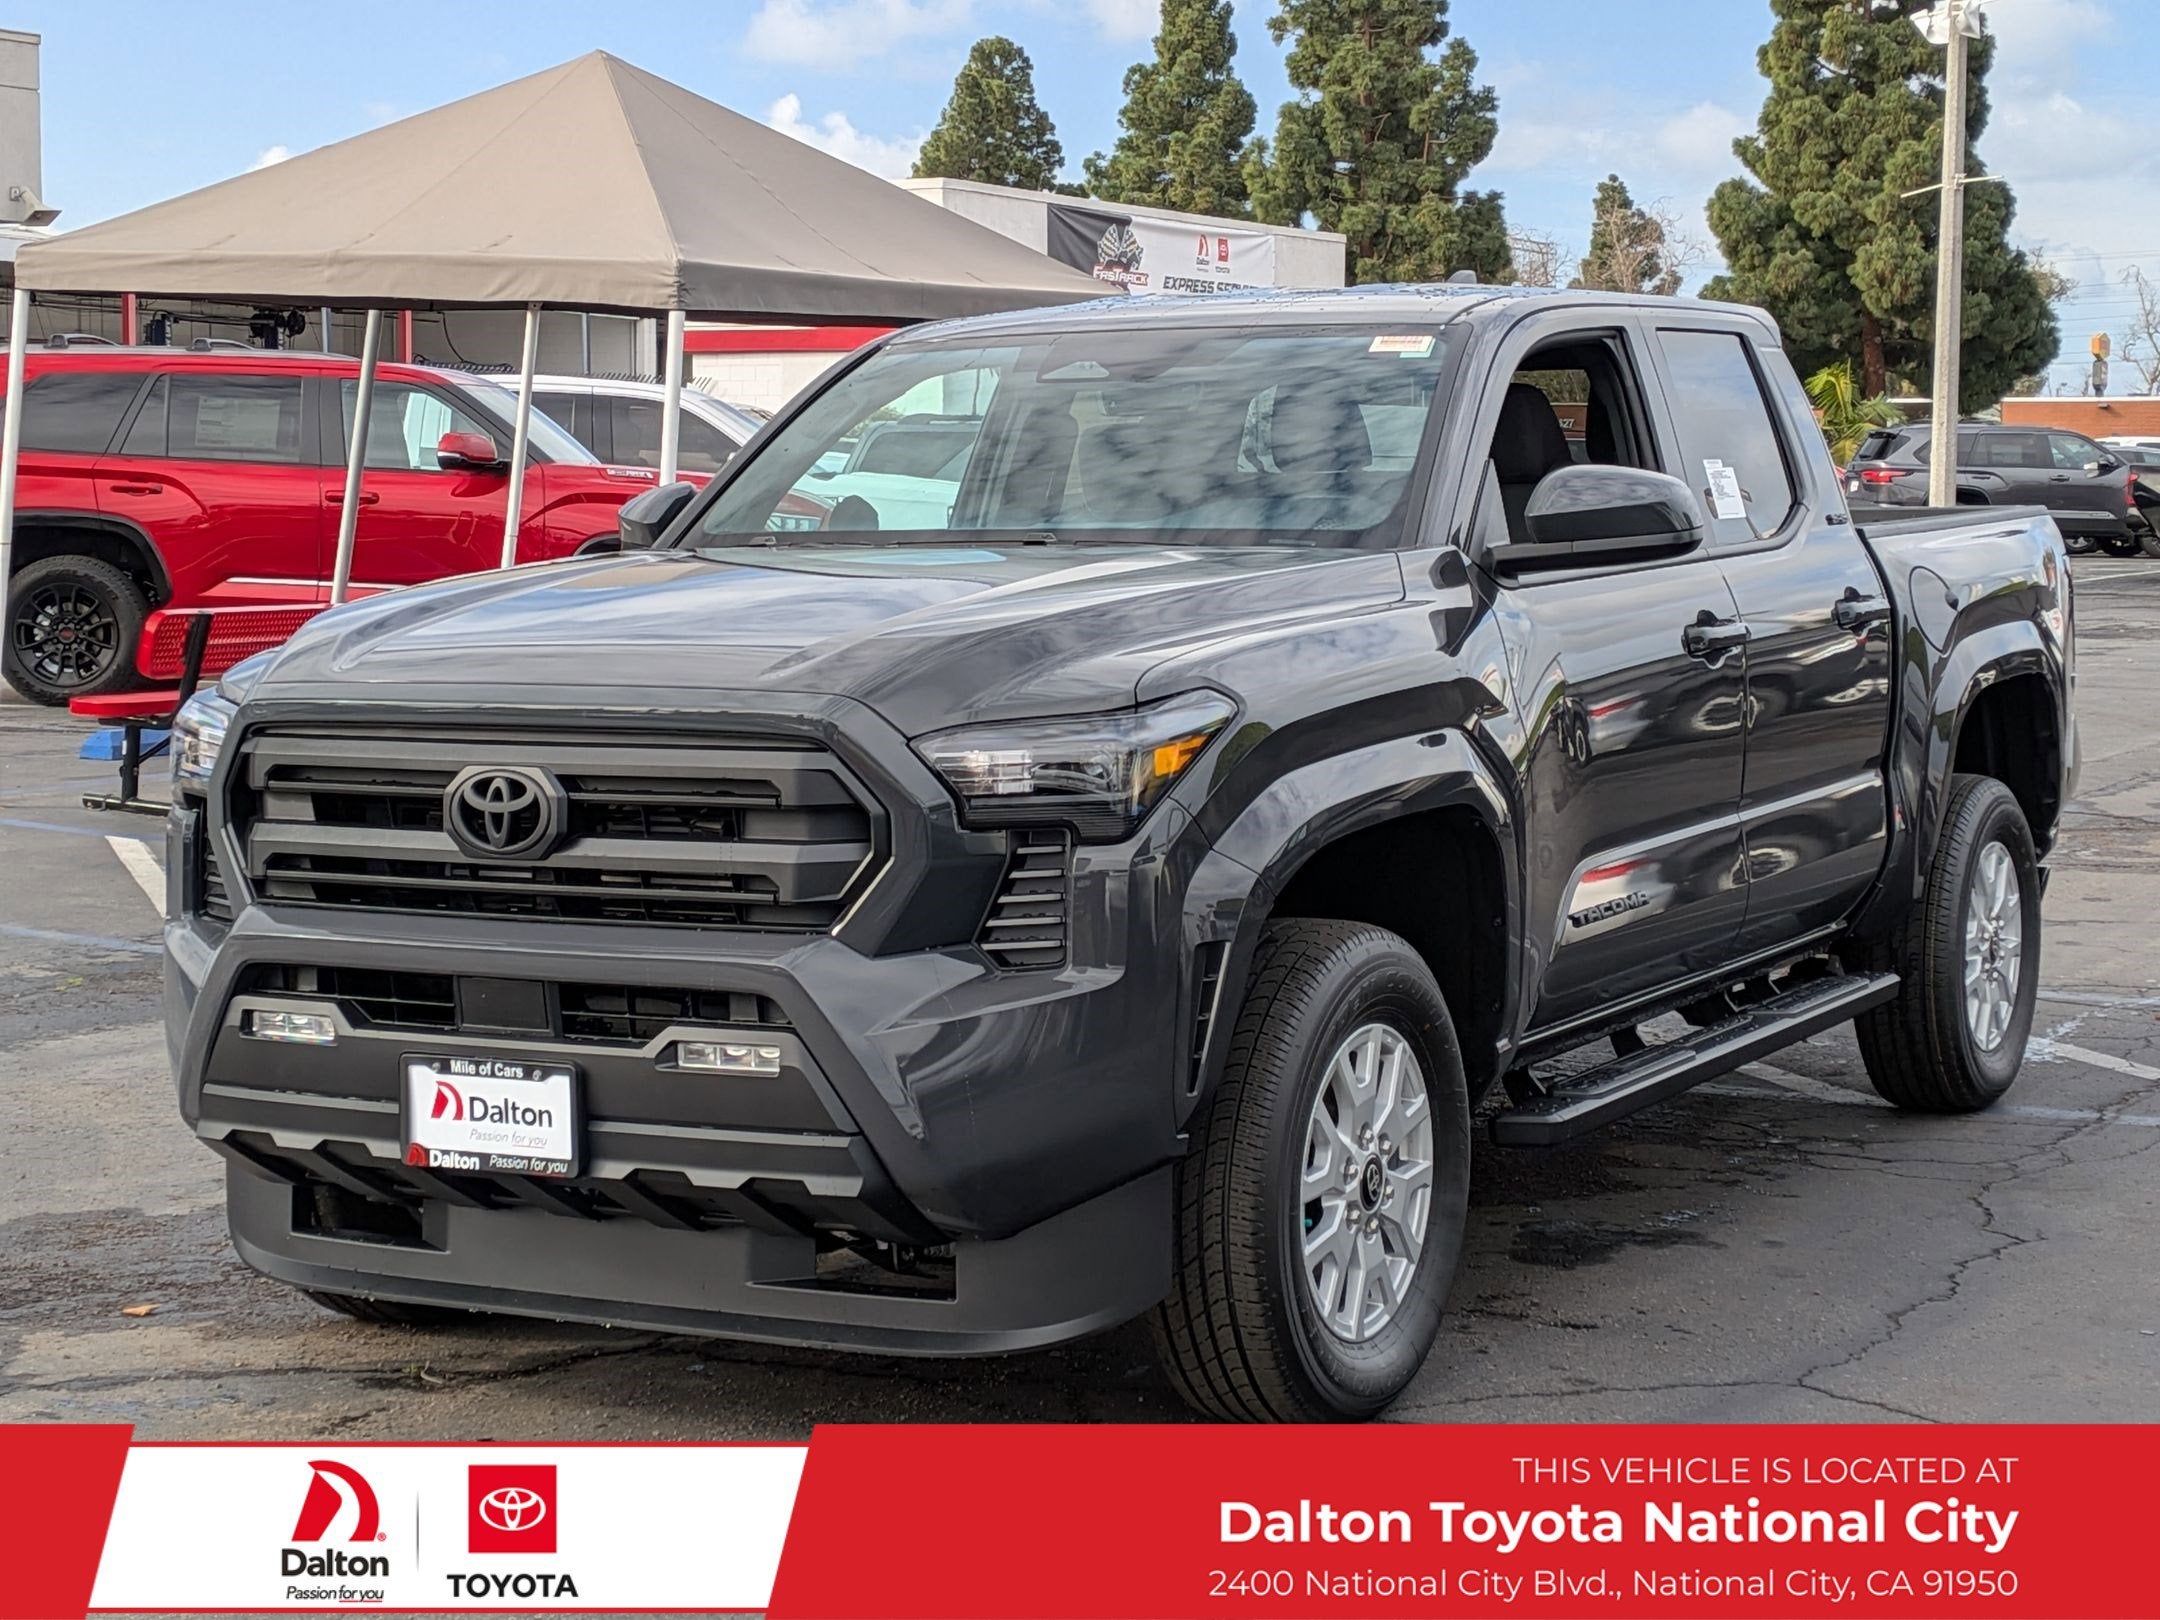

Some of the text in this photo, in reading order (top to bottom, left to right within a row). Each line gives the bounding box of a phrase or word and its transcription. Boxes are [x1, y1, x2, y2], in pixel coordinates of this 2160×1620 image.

[1163, 275, 1215, 294] EXPRESS
[1569, 891, 1650, 928] TACOMA
[450, 1060, 524, 1078] Mile of Cars
[469, 1096, 553, 1127] Dalton
[469, 1129, 548, 1147] Passion for you
[429, 1150, 480, 1170] Dalton
[489, 1154, 568, 1174] Passion for you
